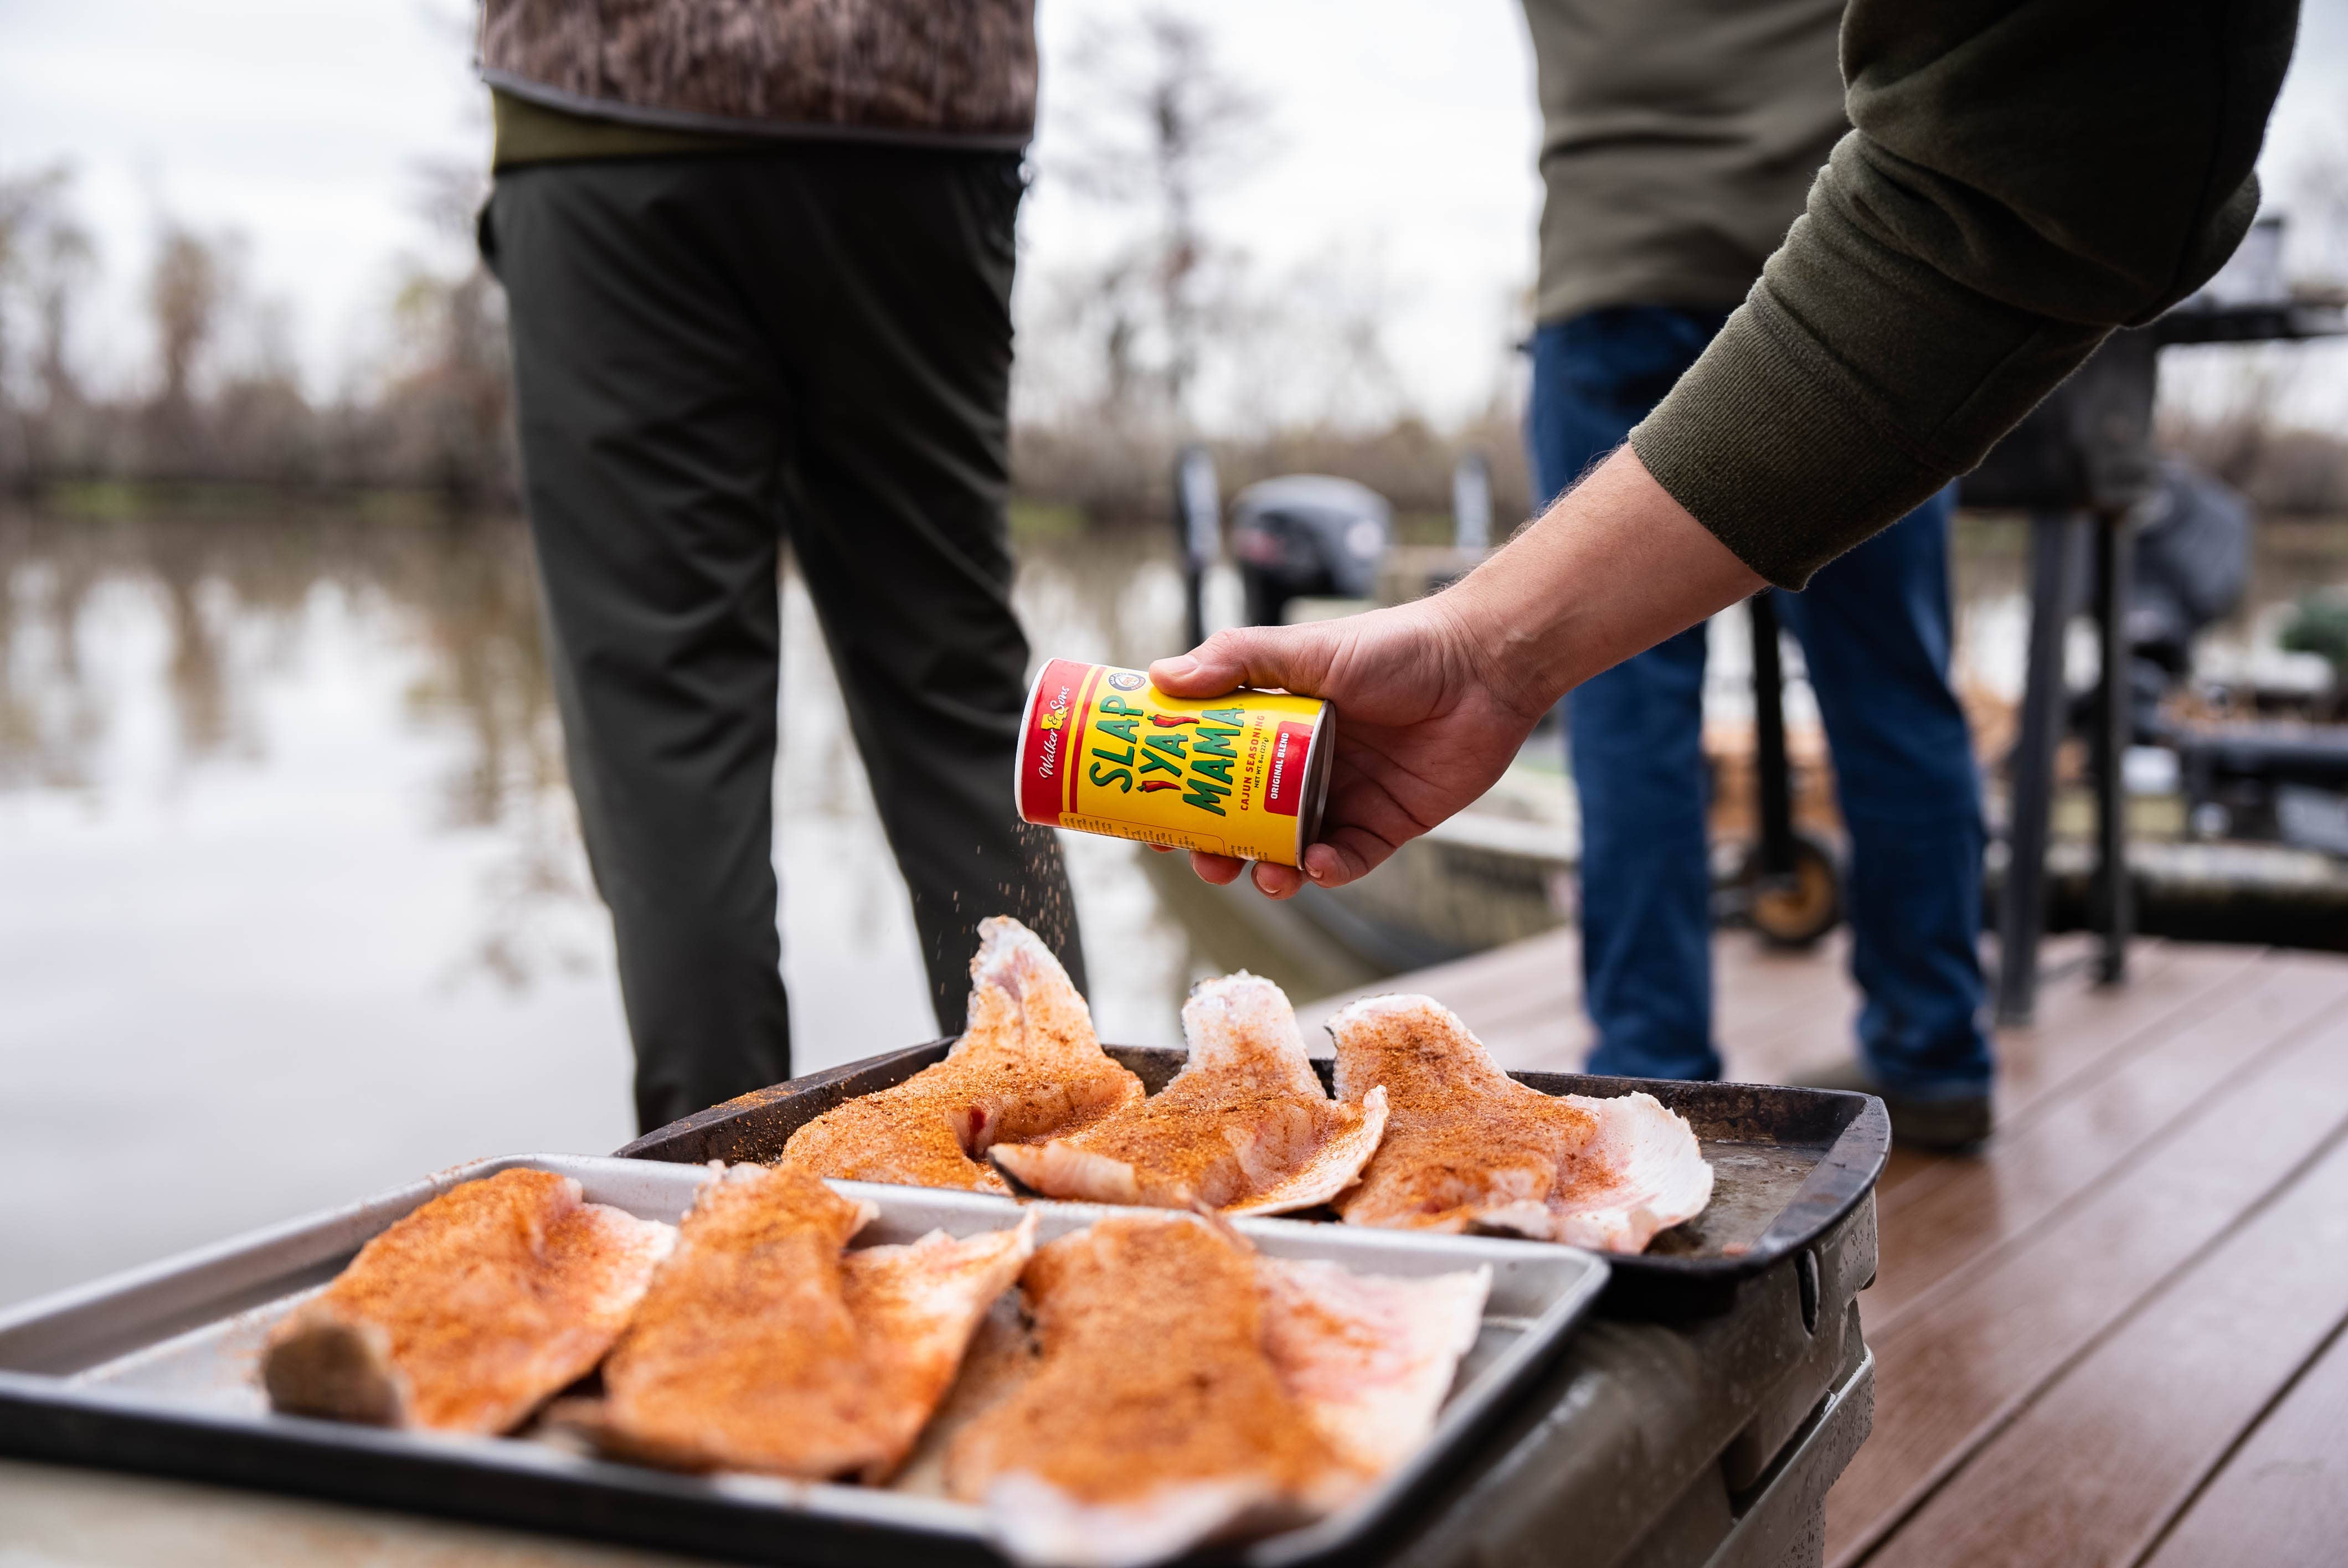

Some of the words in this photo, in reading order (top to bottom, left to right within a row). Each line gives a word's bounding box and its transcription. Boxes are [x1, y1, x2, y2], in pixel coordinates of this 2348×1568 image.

[1048, 715, 1059, 725] &
[1050, 685, 1070, 715] Sons
[1039, 728, 1058, 779] Walker
[1089, 695, 1144, 793] SLAP
[1139, 734, 1188, 778] YA
[1182, 708, 1245, 817] MAMA
[1240, 777, 1252, 811] CAJUN
[1246, 715, 1265, 772] SEASONING
[1270, 759, 1284, 799] ORIGINAL
[1277, 732, 1289, 759] BLEND
